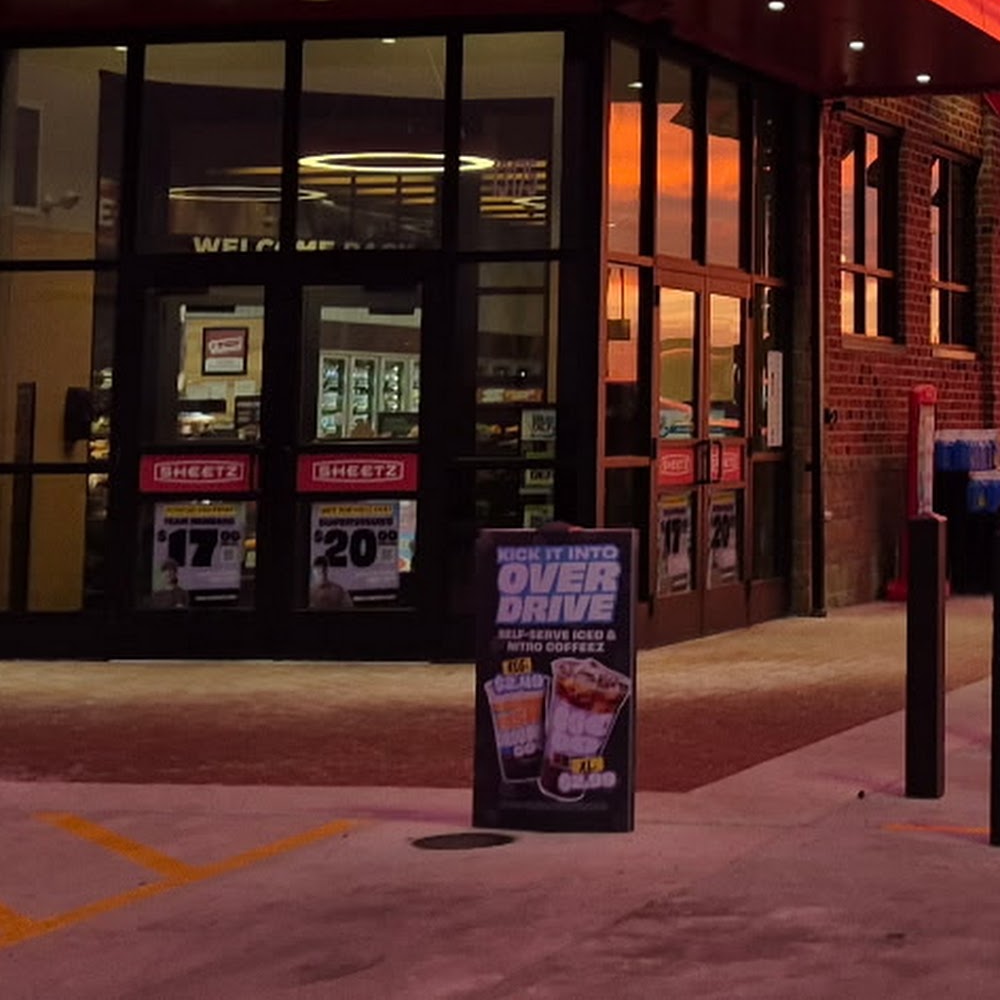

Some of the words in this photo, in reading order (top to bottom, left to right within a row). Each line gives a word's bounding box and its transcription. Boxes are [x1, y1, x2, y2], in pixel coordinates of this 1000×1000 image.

[158, 465, 238, 479] SHEETZ
[317, 464, 398, 479] SHEETZ
[496, 546, 540, 562] KICK
[546, 546, 564, 560] IT
[568, 545, 620, 560] INTO
[497, 561, 621, 594] OVER
[496, 594, 617, 624] DRIVE
[498, 629, 570, 640] SELF-SERVE
[572, 629, 604, 640] ICED
[507, 641, 543, 652] NITRO
[545, 641, 606, 652] COFFEEZ
